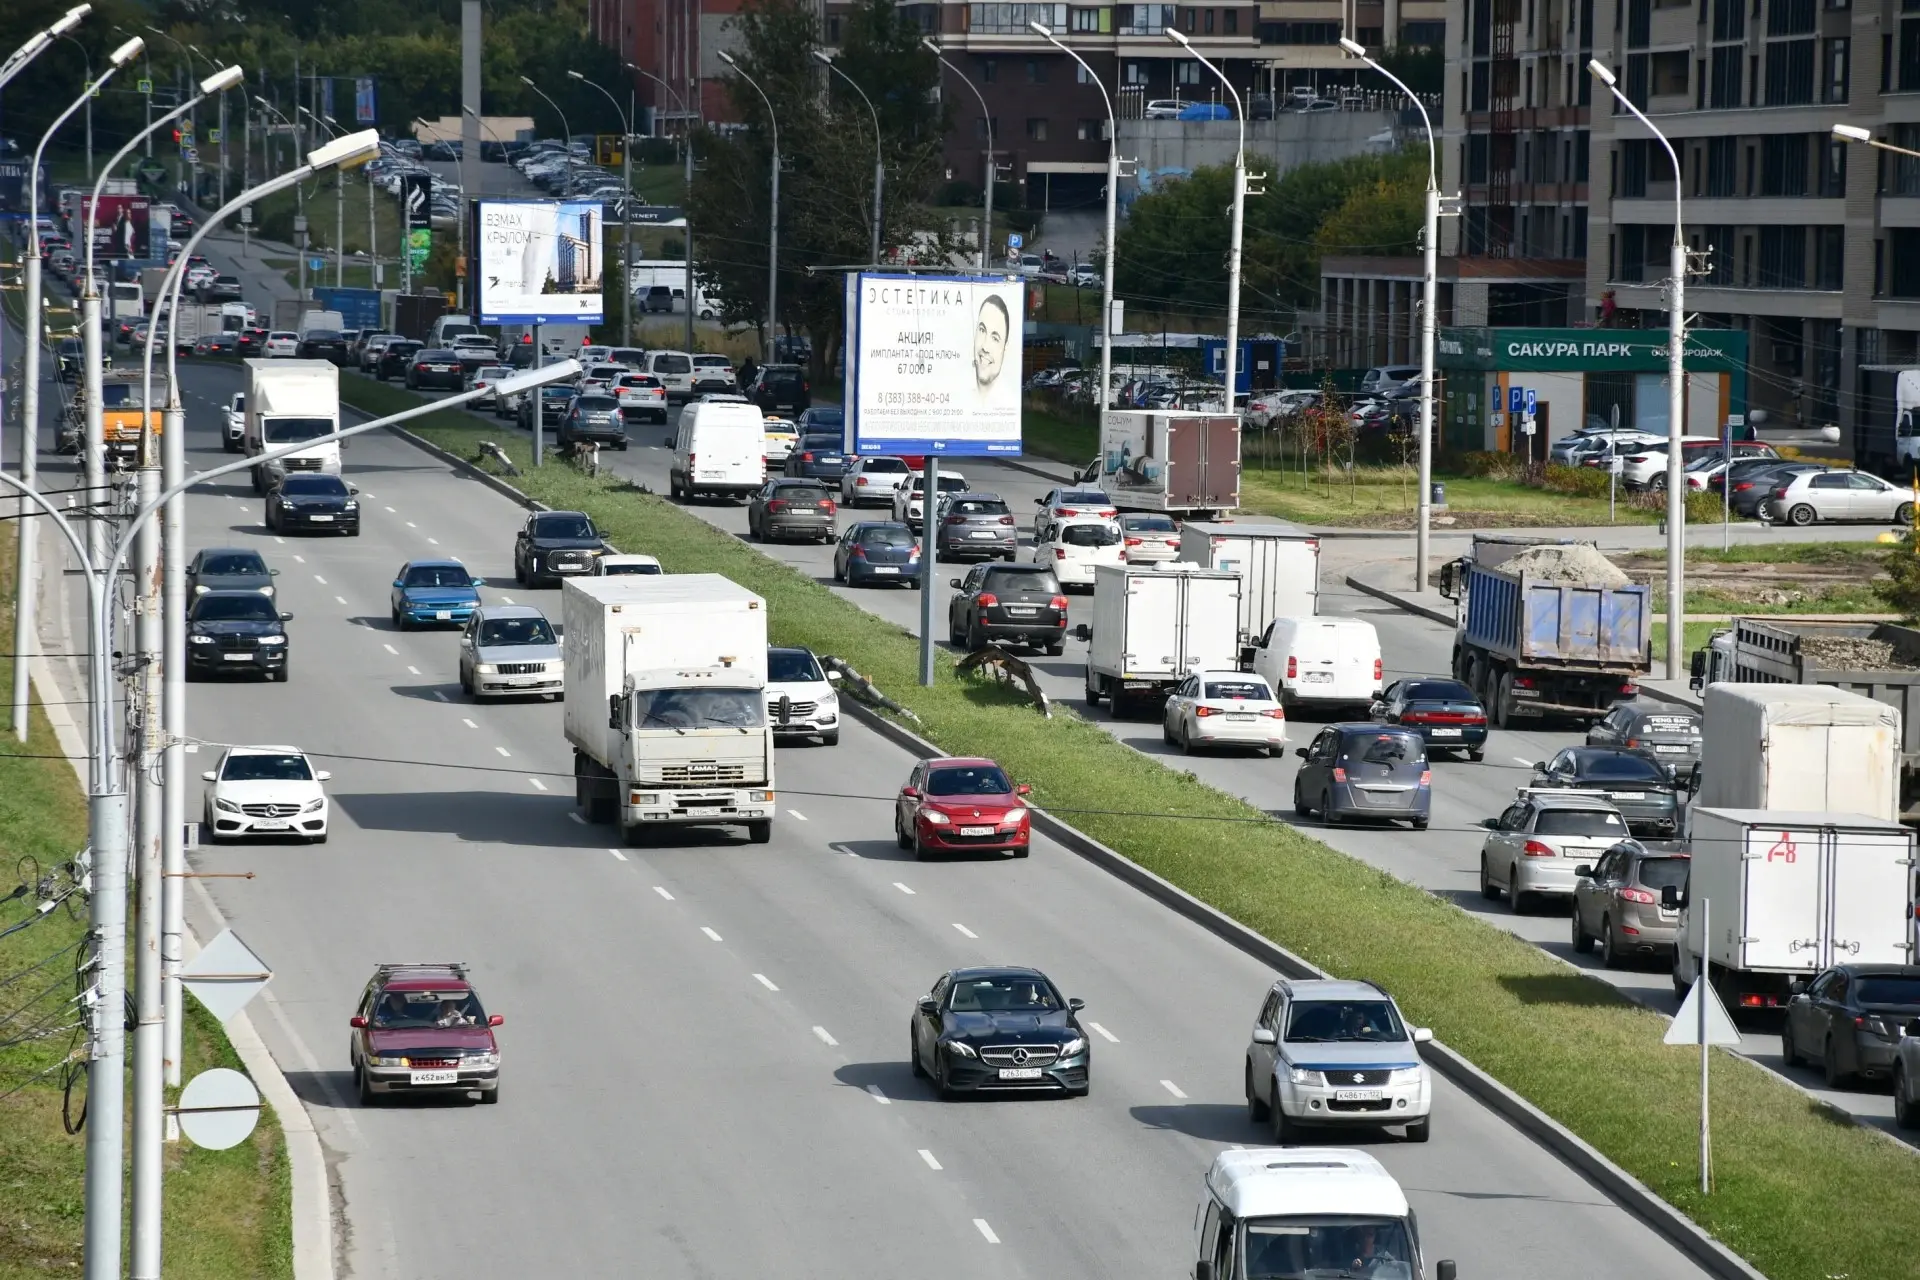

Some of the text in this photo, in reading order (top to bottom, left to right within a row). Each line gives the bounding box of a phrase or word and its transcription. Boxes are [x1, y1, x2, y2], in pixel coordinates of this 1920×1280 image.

[487, 213, 523, 227] ВЗМАХ
[487, 231, 532, 244] КРЫЛОМ
[868, 287, 963, 306] ЭСТЕТИКА
[897, 331, 934, 346] АКЦИЯ!
[870, 348, 961, 360] ИМПЛАНТАТ «ПОД КЛЮЧ»
[1507, 342, 1580, 357] САКУРА
[1583, 343, 1632, 357] ПАРК
[897, 363, 907, 374] 67
[909, 363, 925, 374] 000
[877, 392, 950, 406] 8 (383) 388-40-04
